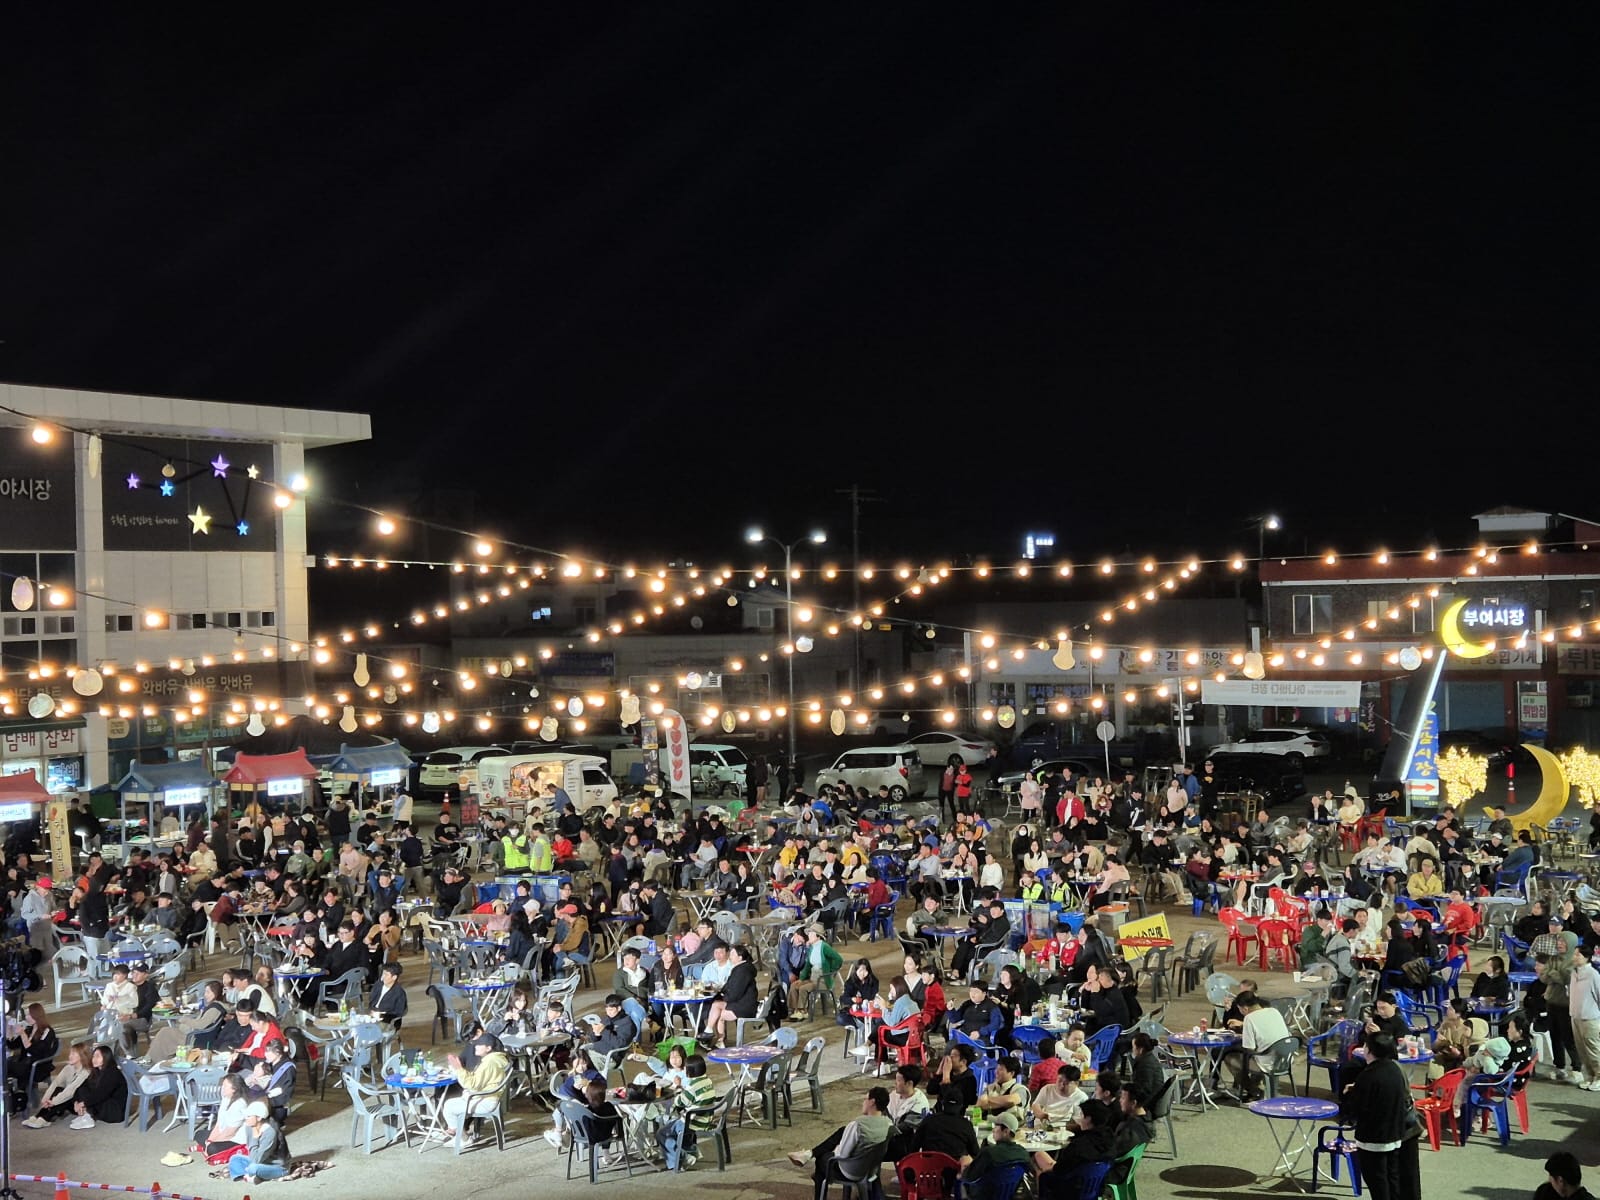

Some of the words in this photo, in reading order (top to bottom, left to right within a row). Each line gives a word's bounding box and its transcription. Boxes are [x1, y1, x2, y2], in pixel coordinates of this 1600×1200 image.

[0, 478, 52, 501] 야시장
[1463, 608, 1525, 627] 부여시장
[142, 679, 178, 696] 와바유
[220, 674, 253, 692] 맛바유
[6, 731, 36, 752] 담배
[45, 729, 76, 749] 잡화
